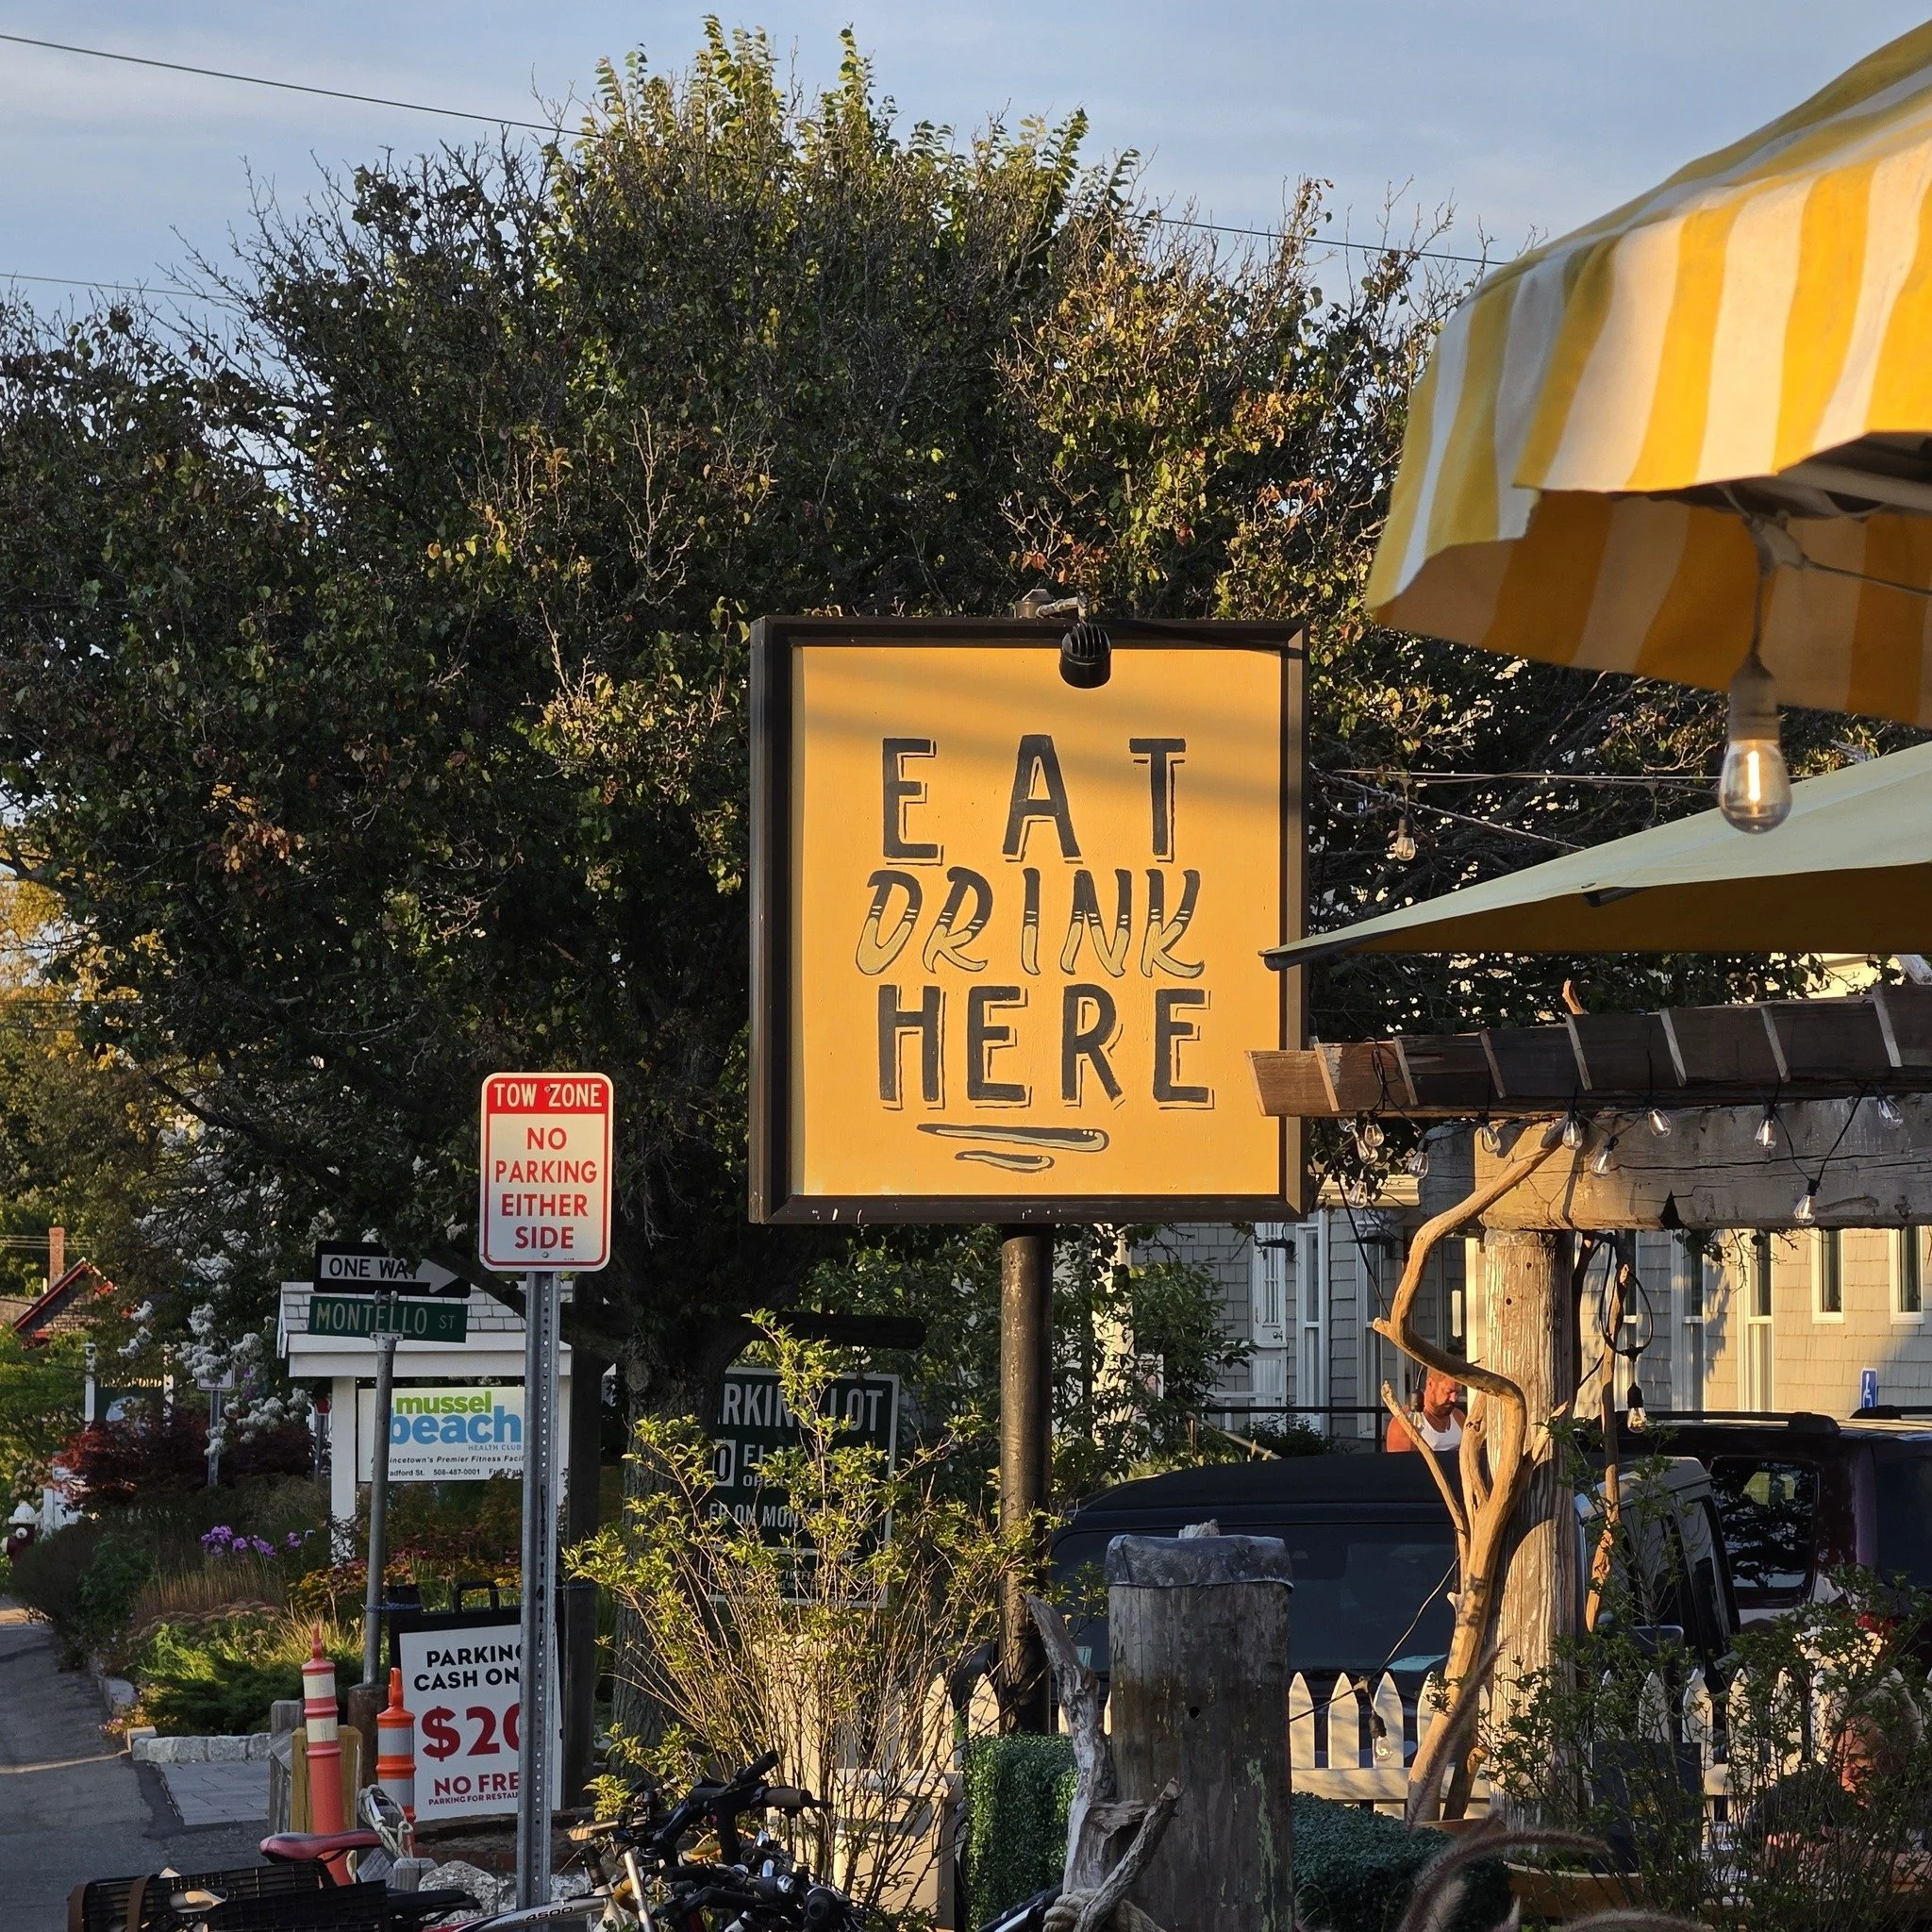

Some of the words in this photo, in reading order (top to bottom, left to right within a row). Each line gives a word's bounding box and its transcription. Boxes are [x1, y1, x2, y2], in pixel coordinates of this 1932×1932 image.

[881, 733, 1186, 865] EAT
[855, 868, 1206, 979] DRINK
[877, 984, 1215, 1110] HERE
[493, 1083, 538, 1108] TOW
[548, 1083, 603, 1108] ZONE
[526, 1127, 568, 1150] NO
[495, 1159, 598, 1184] PARKING
[501, 1193, 589, 1217] EITHER
[514, 1226, 575, 1250] SIDE
[328, 1257, 371, 1277] ONE
[315, 1302, 427, 1335] MONTELLO
[439, 1314, 457, 1329] ST
[395, 1391, 491, 1414] mussel
[718, 1383, 817, 1429] RKIN
[390, 1405, 522, 1444] beach
[433, 1468, 480, 1476] 508-487-0001
[426, 1643, 522, 1668] PARKIN
[413, 1670, 478, 1691] CASH
[485, 1667, 520, 1686] ON
[434, 1775, 472, 1796] NO
[478, 1772, 519, 1793] FRE
[428, 1796, 466, 1806] PARKING
[486, 1791, 518, 1800] RESTAU
[525, 1906, 574, 1922] 4500
